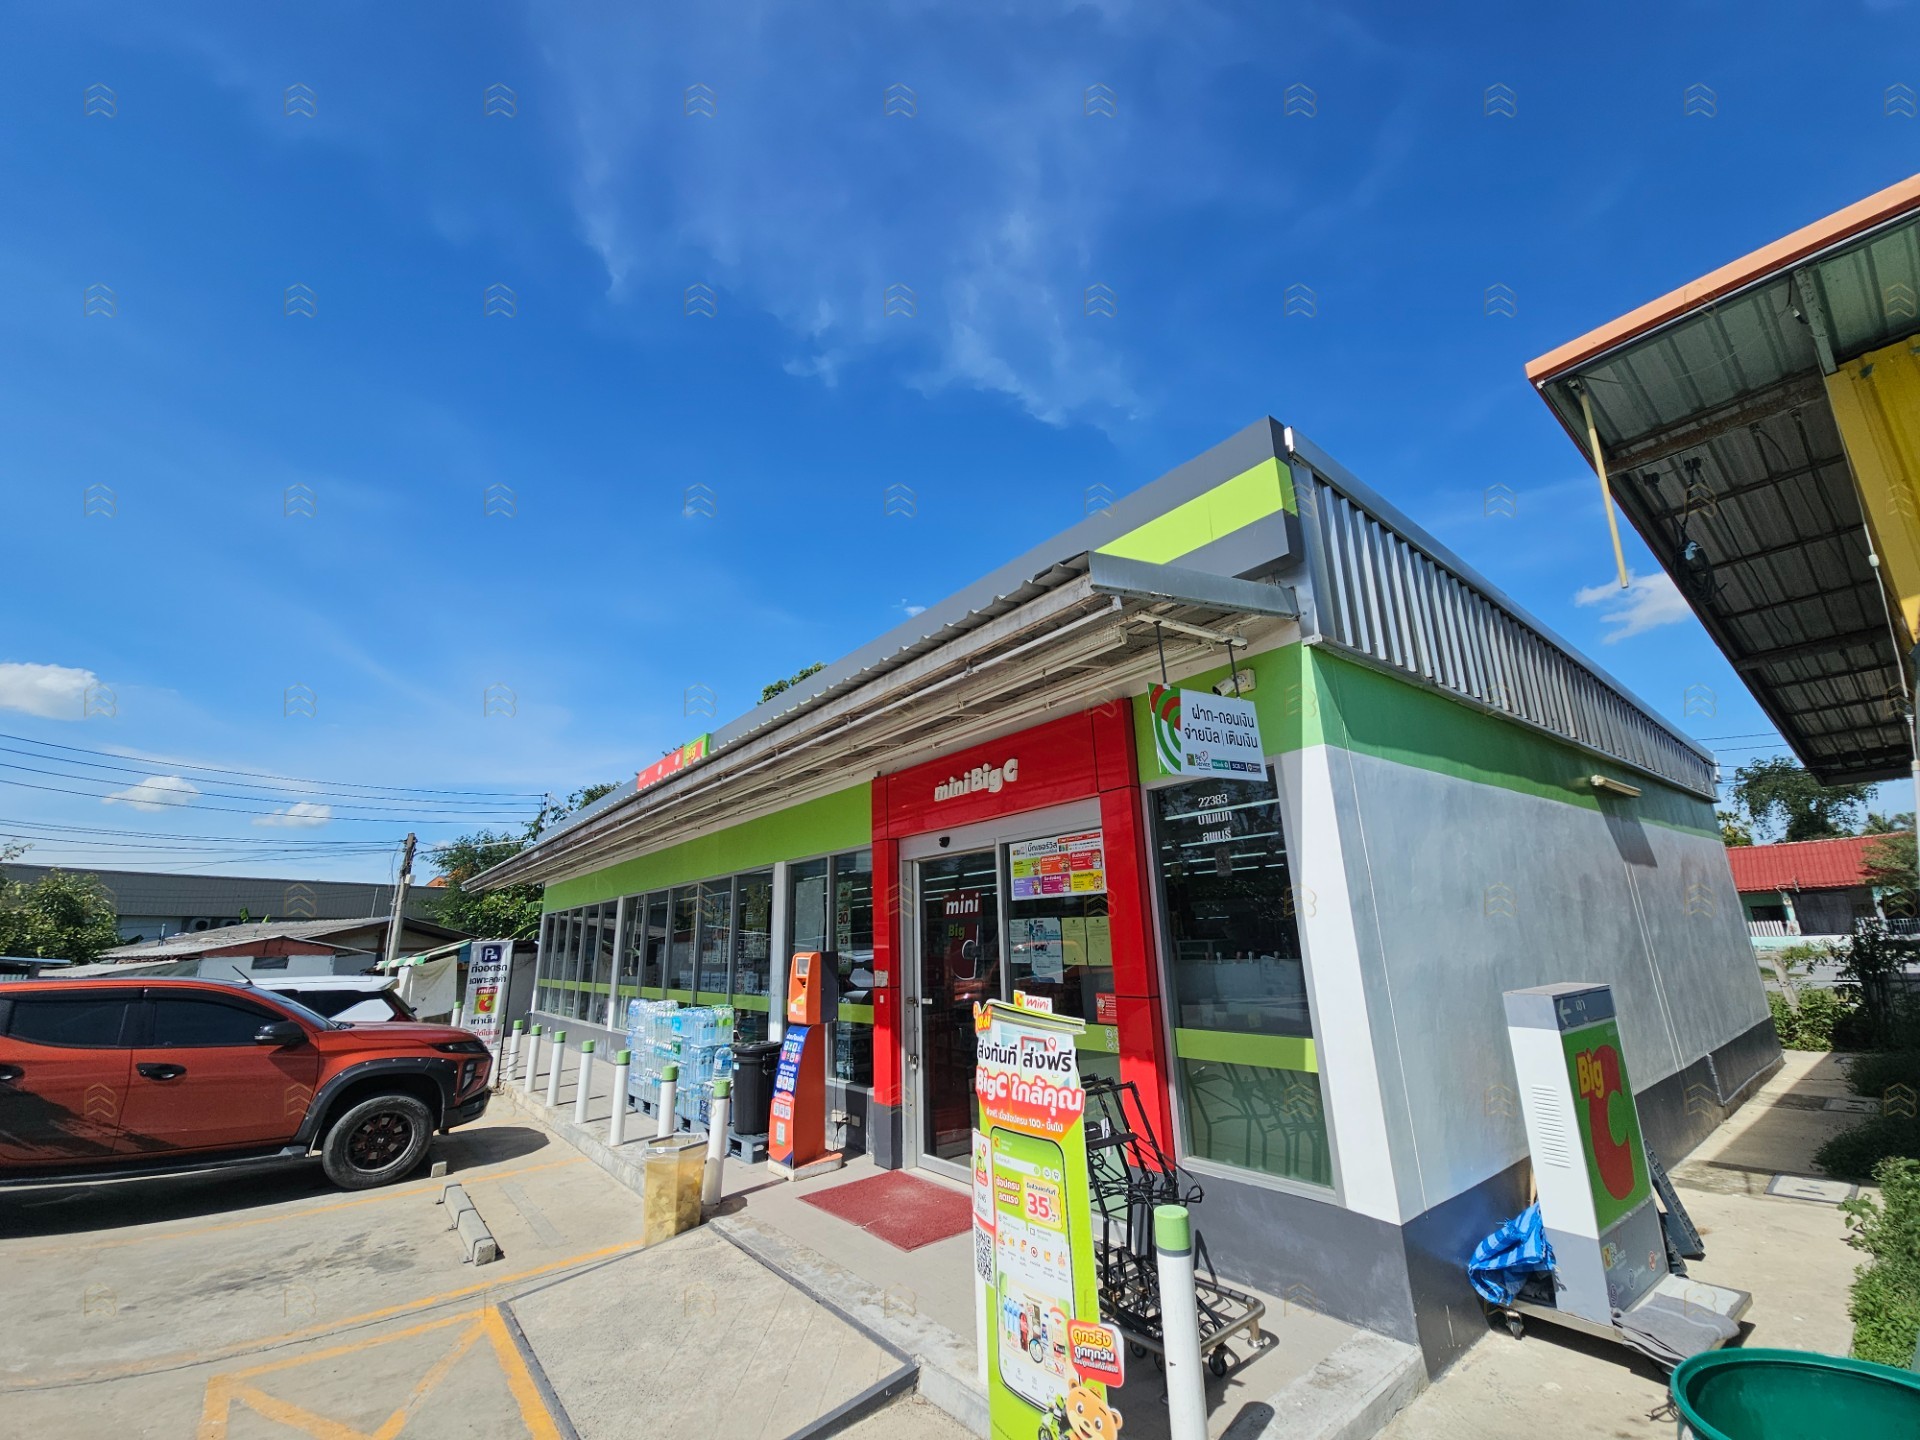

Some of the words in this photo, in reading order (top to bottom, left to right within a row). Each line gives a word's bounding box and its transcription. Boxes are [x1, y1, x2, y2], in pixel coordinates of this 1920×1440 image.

[1191, 704, 1255, 729] ฝาก-ถอนเงิน
[1198, 793, 1228, 808] 22383
[945, 892, 979, 915] mini
[1025, 996, 1050, 1011] mini
[977, 1039, 1018, 1066] ส่งทันที
[1022, 1045, 1073, 1073] ส่งฟรี
[1576, 1050, 1605, 1099] Big
[1011, 1075, 1083, 1116] ใกล้คุณ
[1073, 1328, 1112, 1347] ถูกจริง
[1074, 1345, 1115, 1363] ถูกทุกวัน
